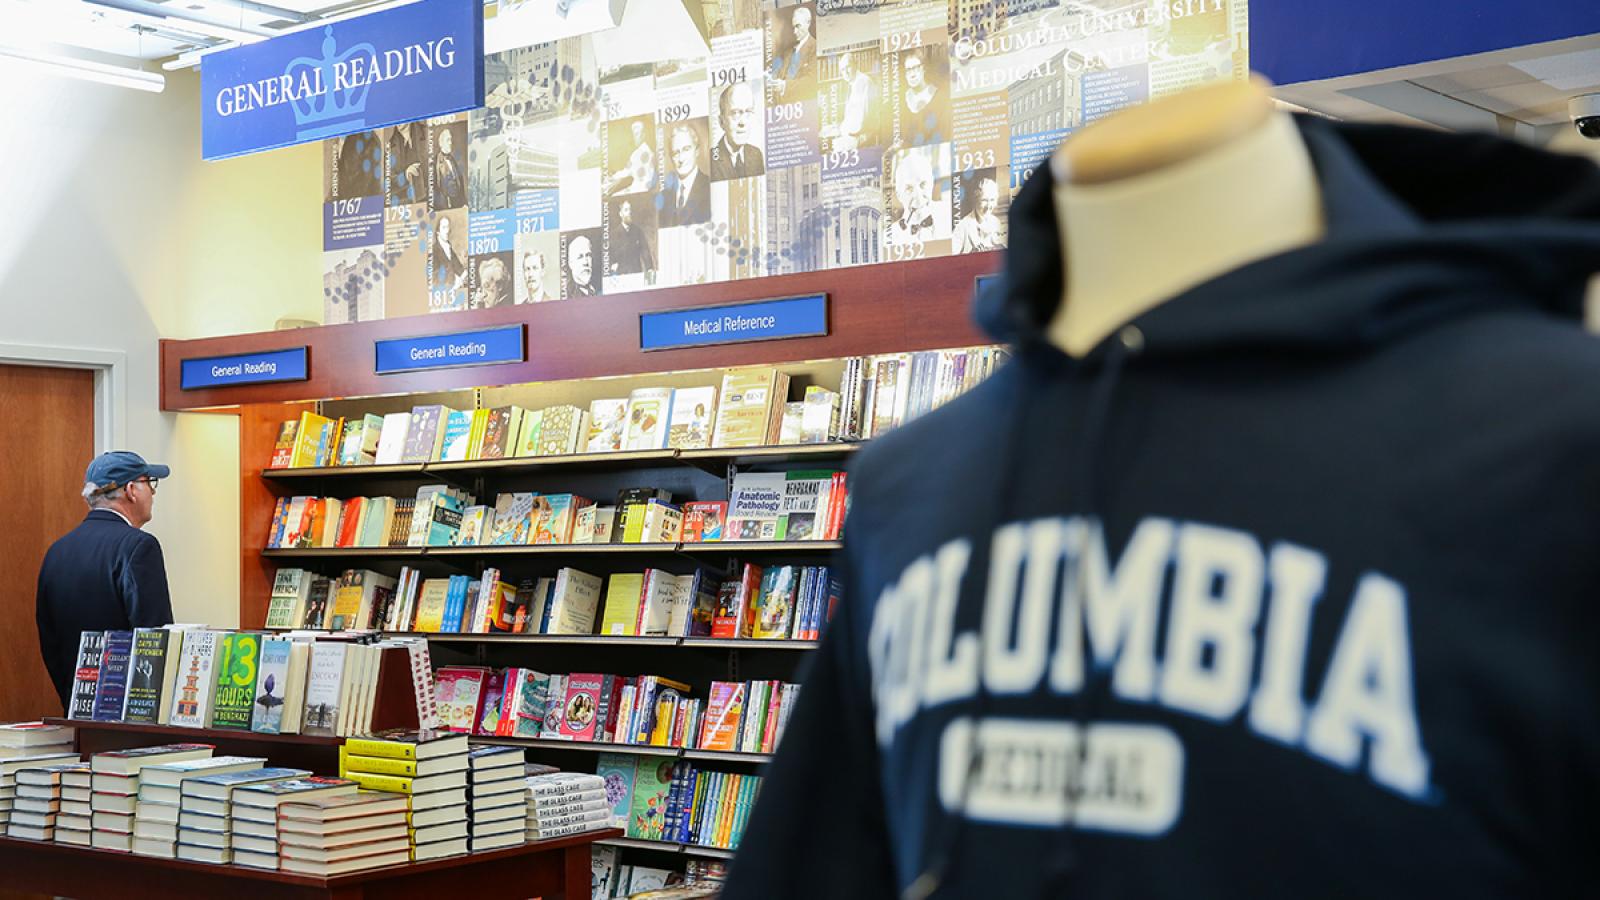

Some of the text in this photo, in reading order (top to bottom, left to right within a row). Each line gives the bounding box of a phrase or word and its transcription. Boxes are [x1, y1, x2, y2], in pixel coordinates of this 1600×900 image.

[954, 24, 1070, 61] COLUMBIA
[1080, 0, 1225, 37] UNIVERSITY
[882, 31, 922, 53] 1924
[216, 36, 456, 117] GENERAL READING
[712, 66, 747, 88] 1904
[954, 57, 1057, 93] MEDICAL
[658, 103, 691, 125] 1899
[767, 103, 803, 124] 1908
[821, 149, 861, 171] 1923
[953, 149, 995, 172] 1933
[332, 197, 362, 217] 1767
[385, 206, 412, 222] 1795
[885, 187, 893, 246] LAWRENC
[516, 216, 545, 235] 1871
[470, 237, 499, 256] 1870
[885, 241, 926, 263] 1932
[602, 251, 610, 277] JOHN
[428, 288, 457, 307] 1813
[684, 315, 776, 336] Medical Reference
[410, 342, 486, 361] General Reading
[211, 361, 277, 377] General Reading
[738, 490, 781, 501] Anatomic
[786, 480, 820, 496] NEUROANAT
[736, 501, 781, 512] Pathology
[218, 636, 257, 686] 13
[868, 514, 1432, 800] COLUMBIA
[74, 699, 92, 713] RISE
[215, 687, 253, 706] HOURS
[547, 785, 565, 794] GLASS
[565, 783, 580, 791] CAGE
[550, 796, 568, 805] GLASS
[568, 794, 582, 802] CAGE
[540, 809, 550, 817] THE
[551, 806, 569, 815] GLASS
[553, 817, 570, 826] GLASS
[571, 814, 585, 823] CAGE
[554, 827, 572, 836] GLASS
[572, 824, 586, 832] CAGE
